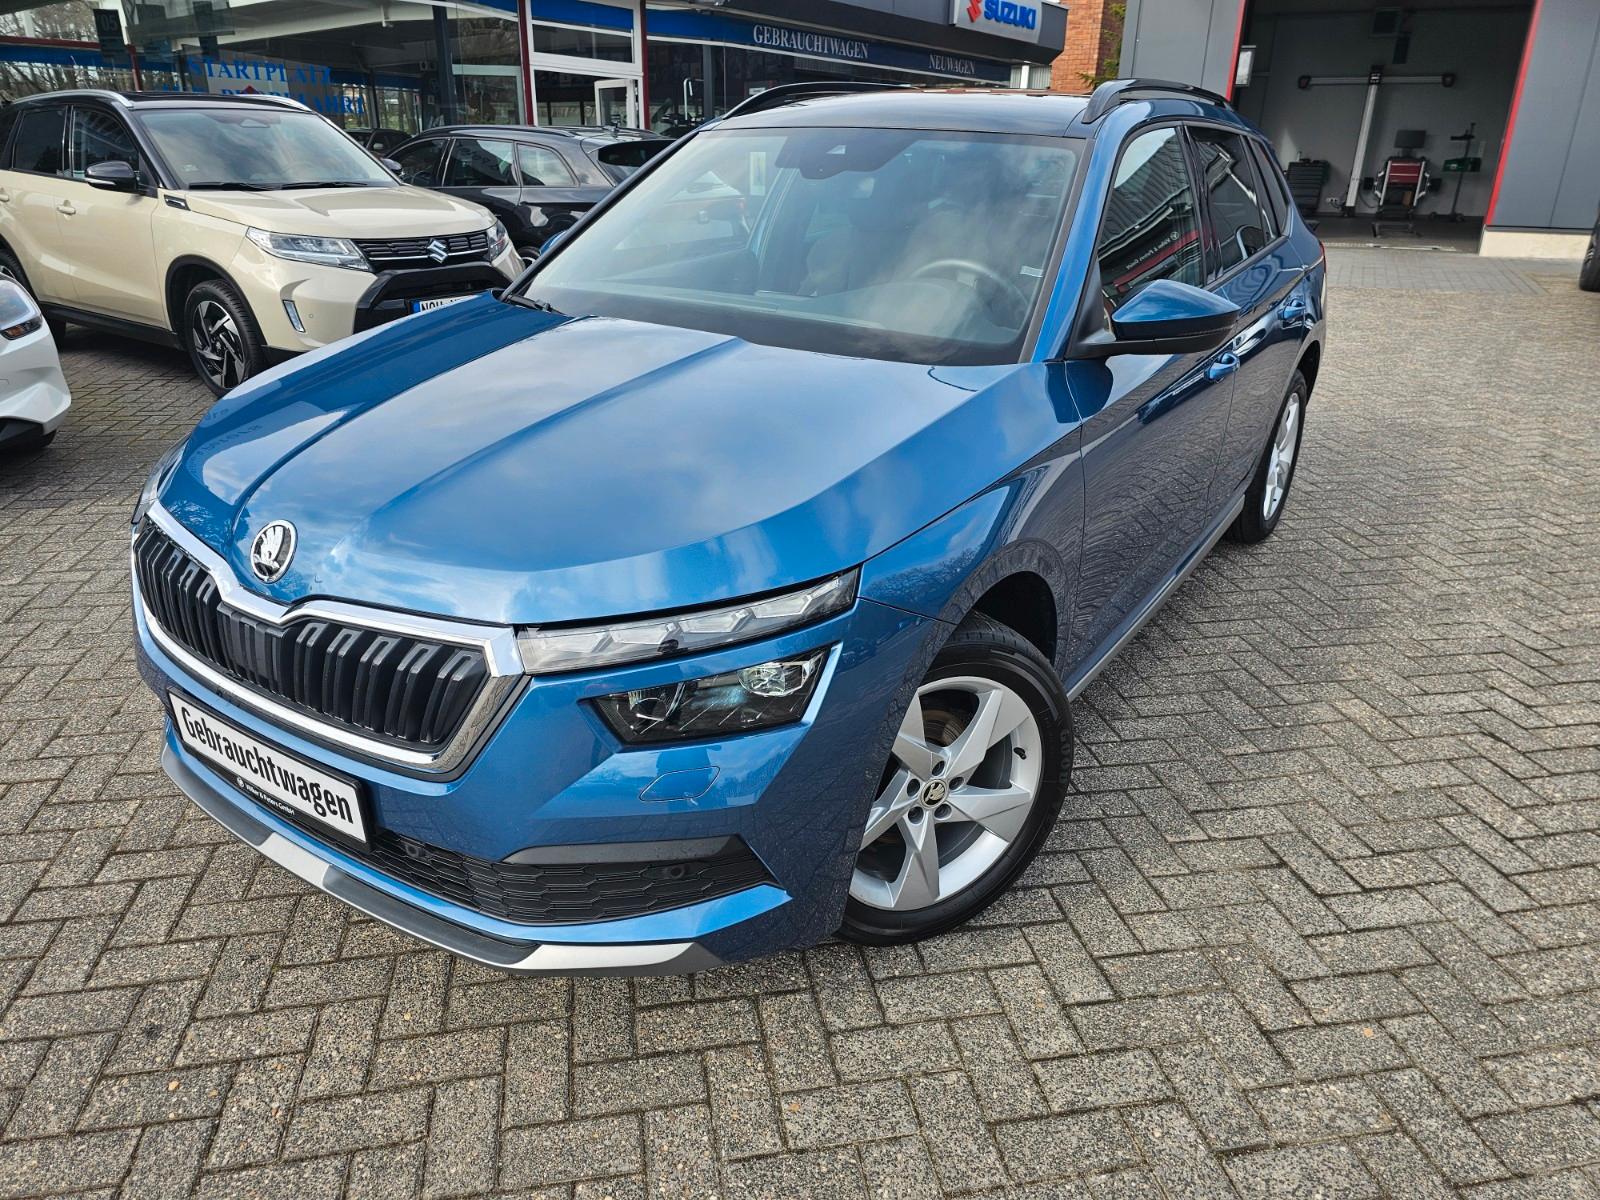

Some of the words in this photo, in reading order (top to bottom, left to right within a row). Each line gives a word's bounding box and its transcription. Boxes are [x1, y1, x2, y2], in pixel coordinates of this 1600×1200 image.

[984, 0, 1037, 30] SUZUKI
[753, 24, 869, 59] GEBRAUCHTWAGEN
[928, 54, 976, 74] NEUWAGEN
[180, 705, 355, 825] Gebrauchtwagen
